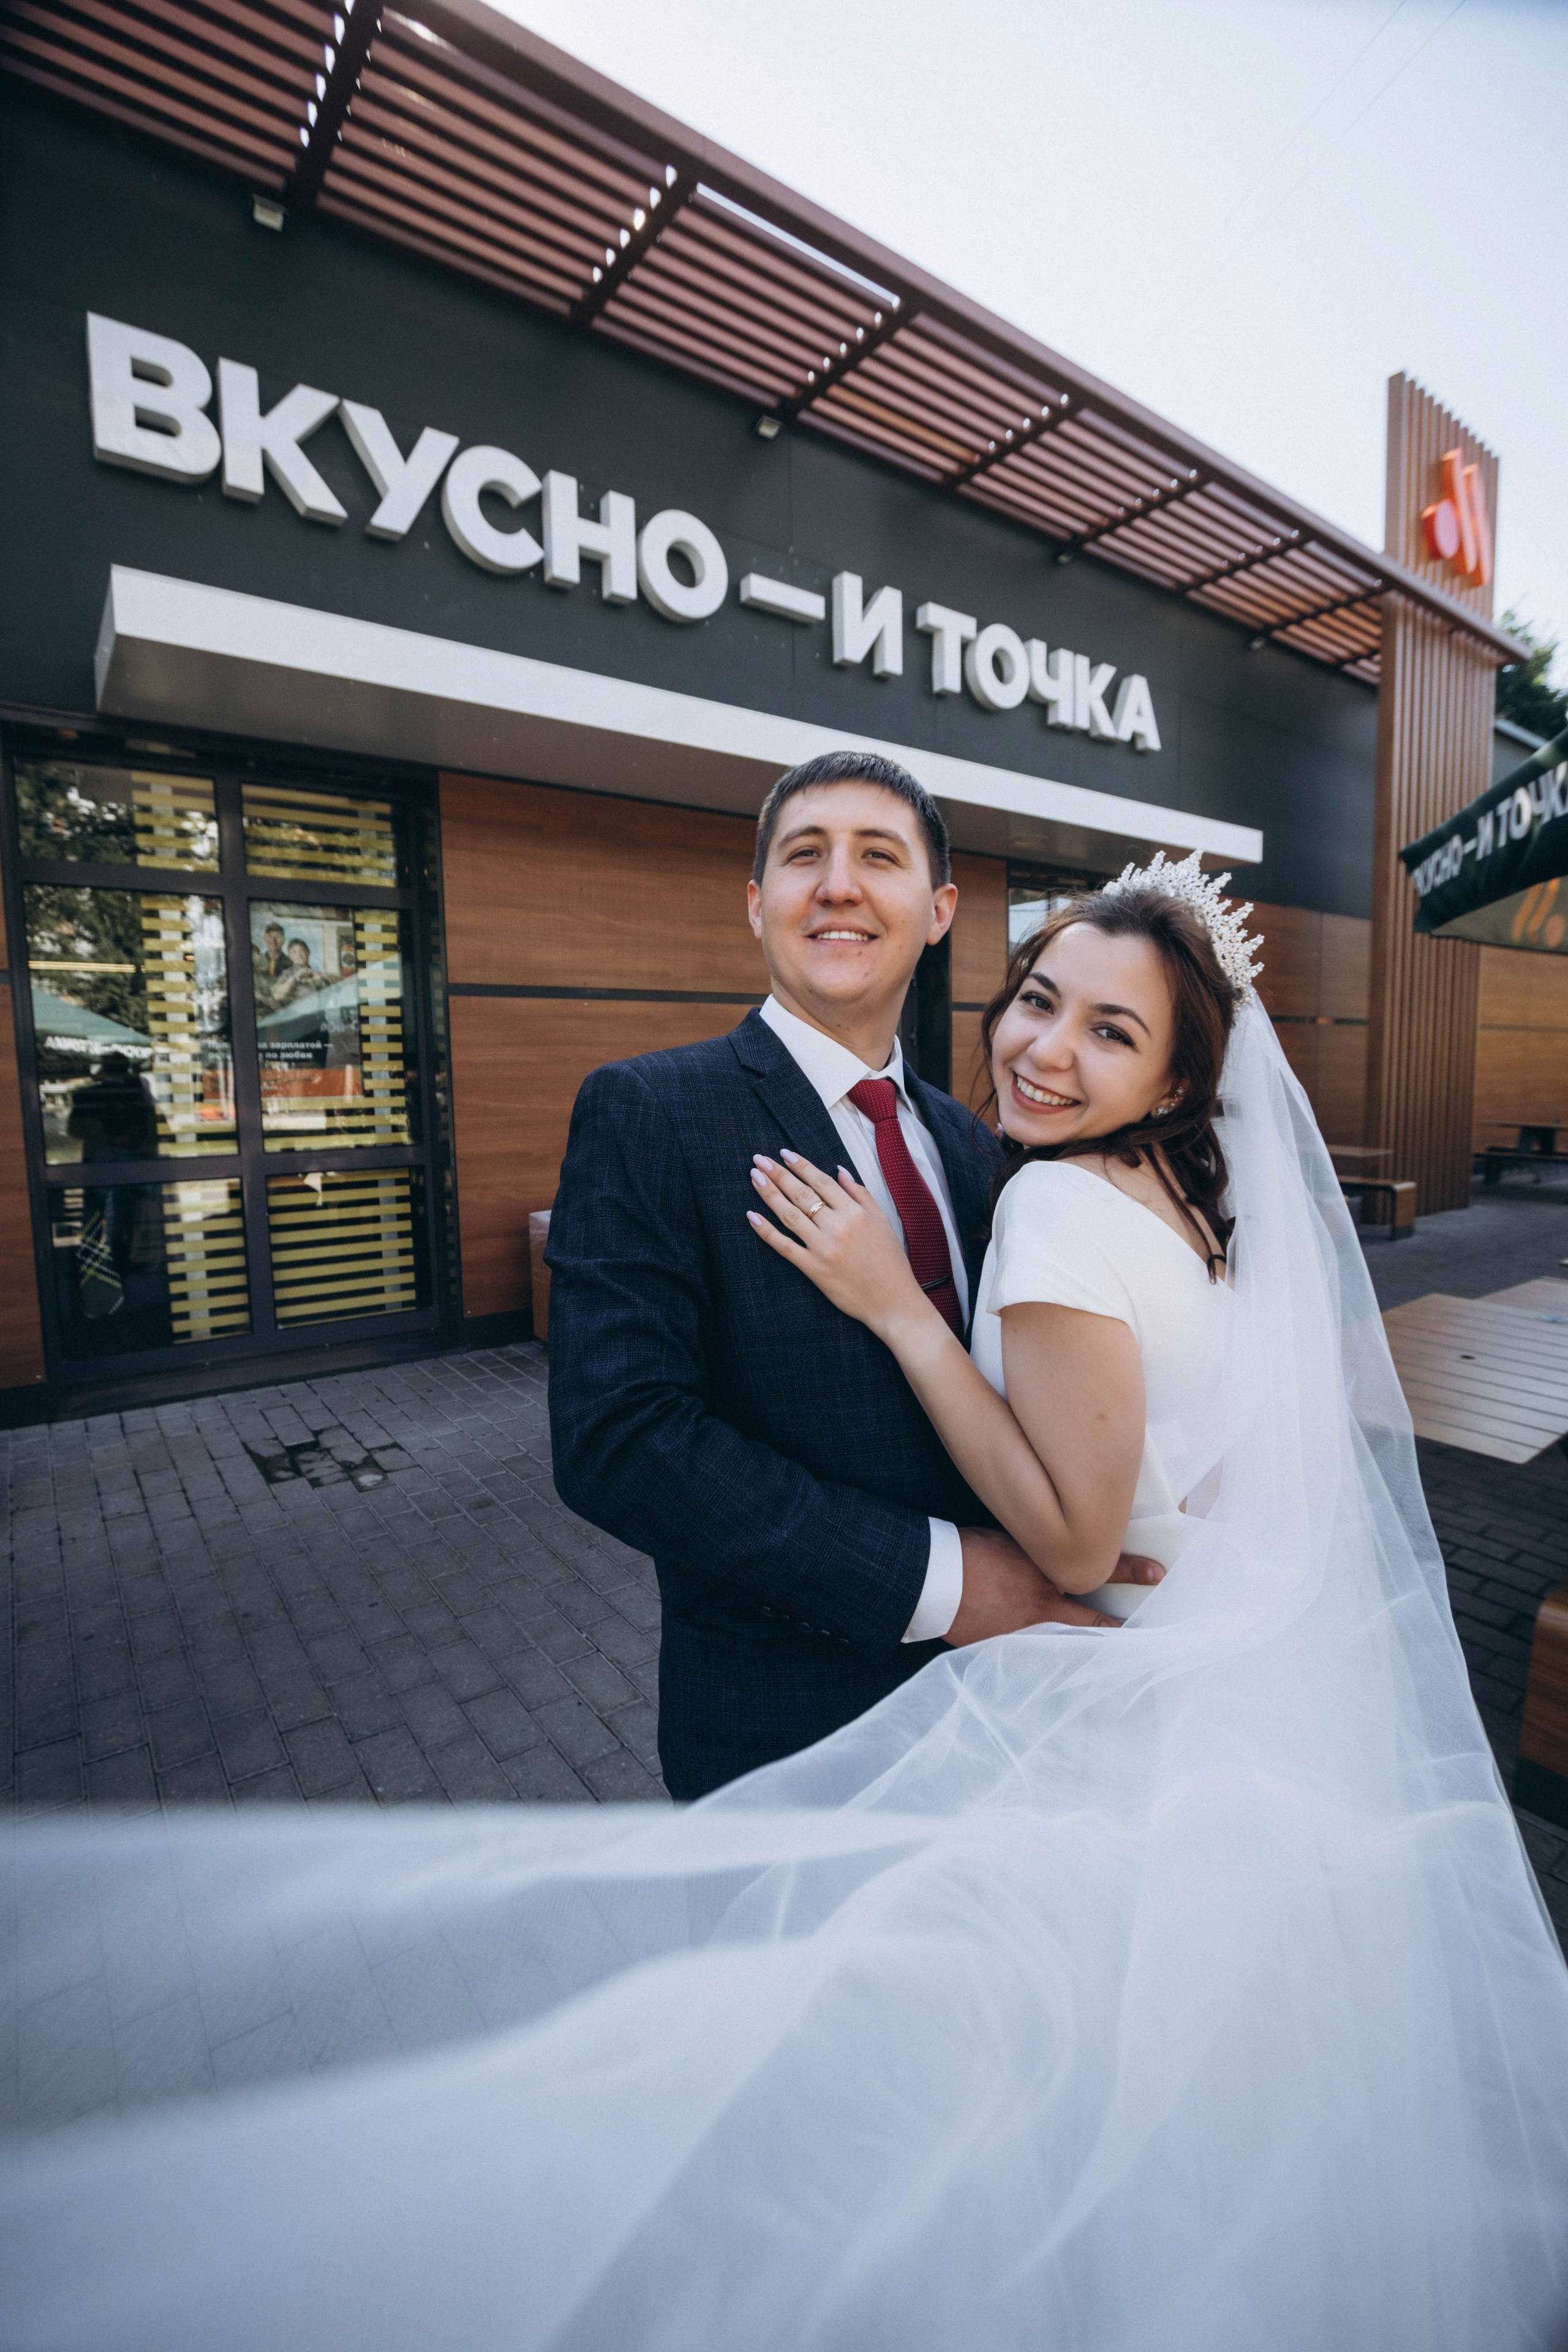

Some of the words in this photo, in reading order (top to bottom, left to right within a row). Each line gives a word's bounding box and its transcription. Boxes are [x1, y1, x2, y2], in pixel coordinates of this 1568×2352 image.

[87, 311, 729, 622] ВКУСНО
[831, 570, 903, 677] И
[916, 601, 1162, 752] ТОЧКА
[1496, 760, 1568, 848] ТОЧК
[270, 1040, 322, 1050] зарплатой
[280, 1050, 313, 1060] любви
